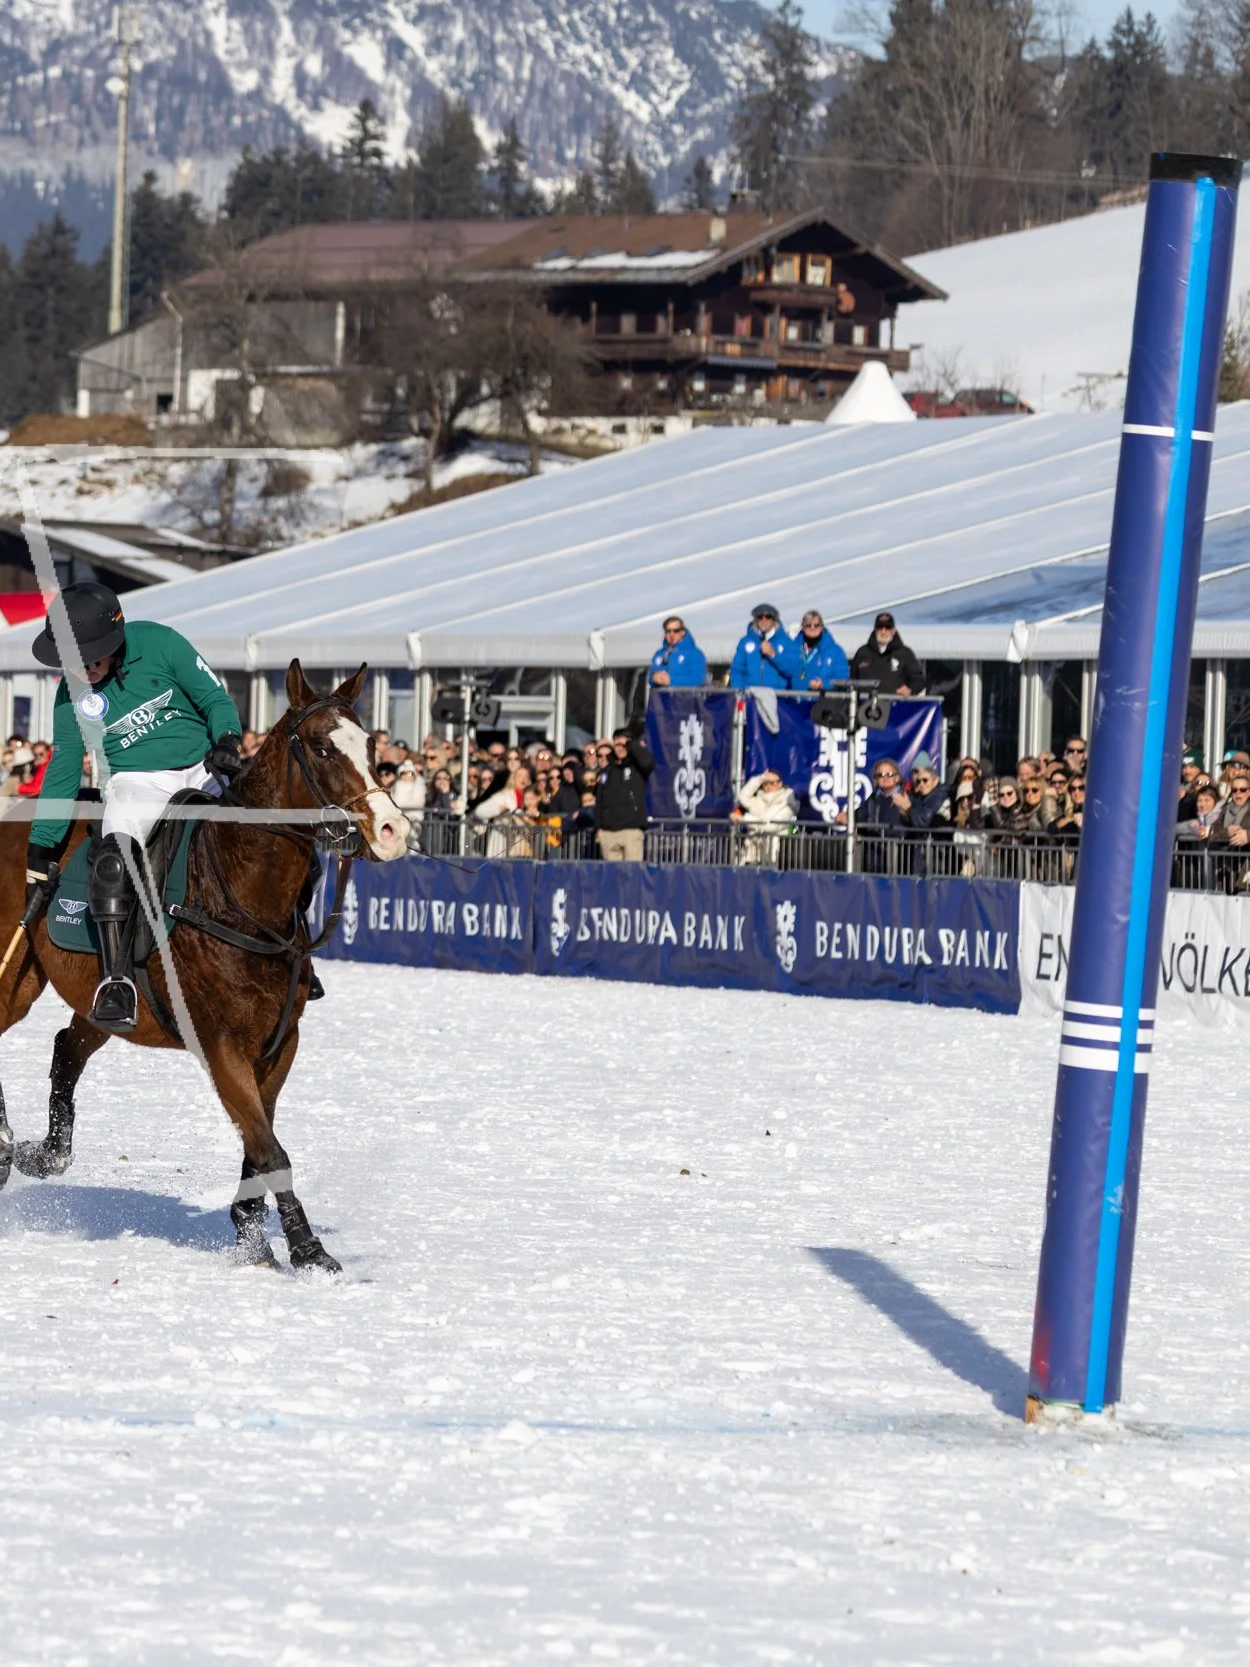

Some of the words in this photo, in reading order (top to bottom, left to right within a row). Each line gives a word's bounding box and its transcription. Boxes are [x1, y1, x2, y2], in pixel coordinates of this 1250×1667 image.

[196, 655, 221, 687] 1
[119, 709, 182, 749] BENTLEY
[55, 915, 82, 926] BENTLEY
[367, 896, 456, 937] BENDURA
[463, 902, 523, 940] BANK
[683, 911, 746, 952] BANK
[815, 920, 932, 966] BENDURA
[938, 927, 1010, 971] BANK
